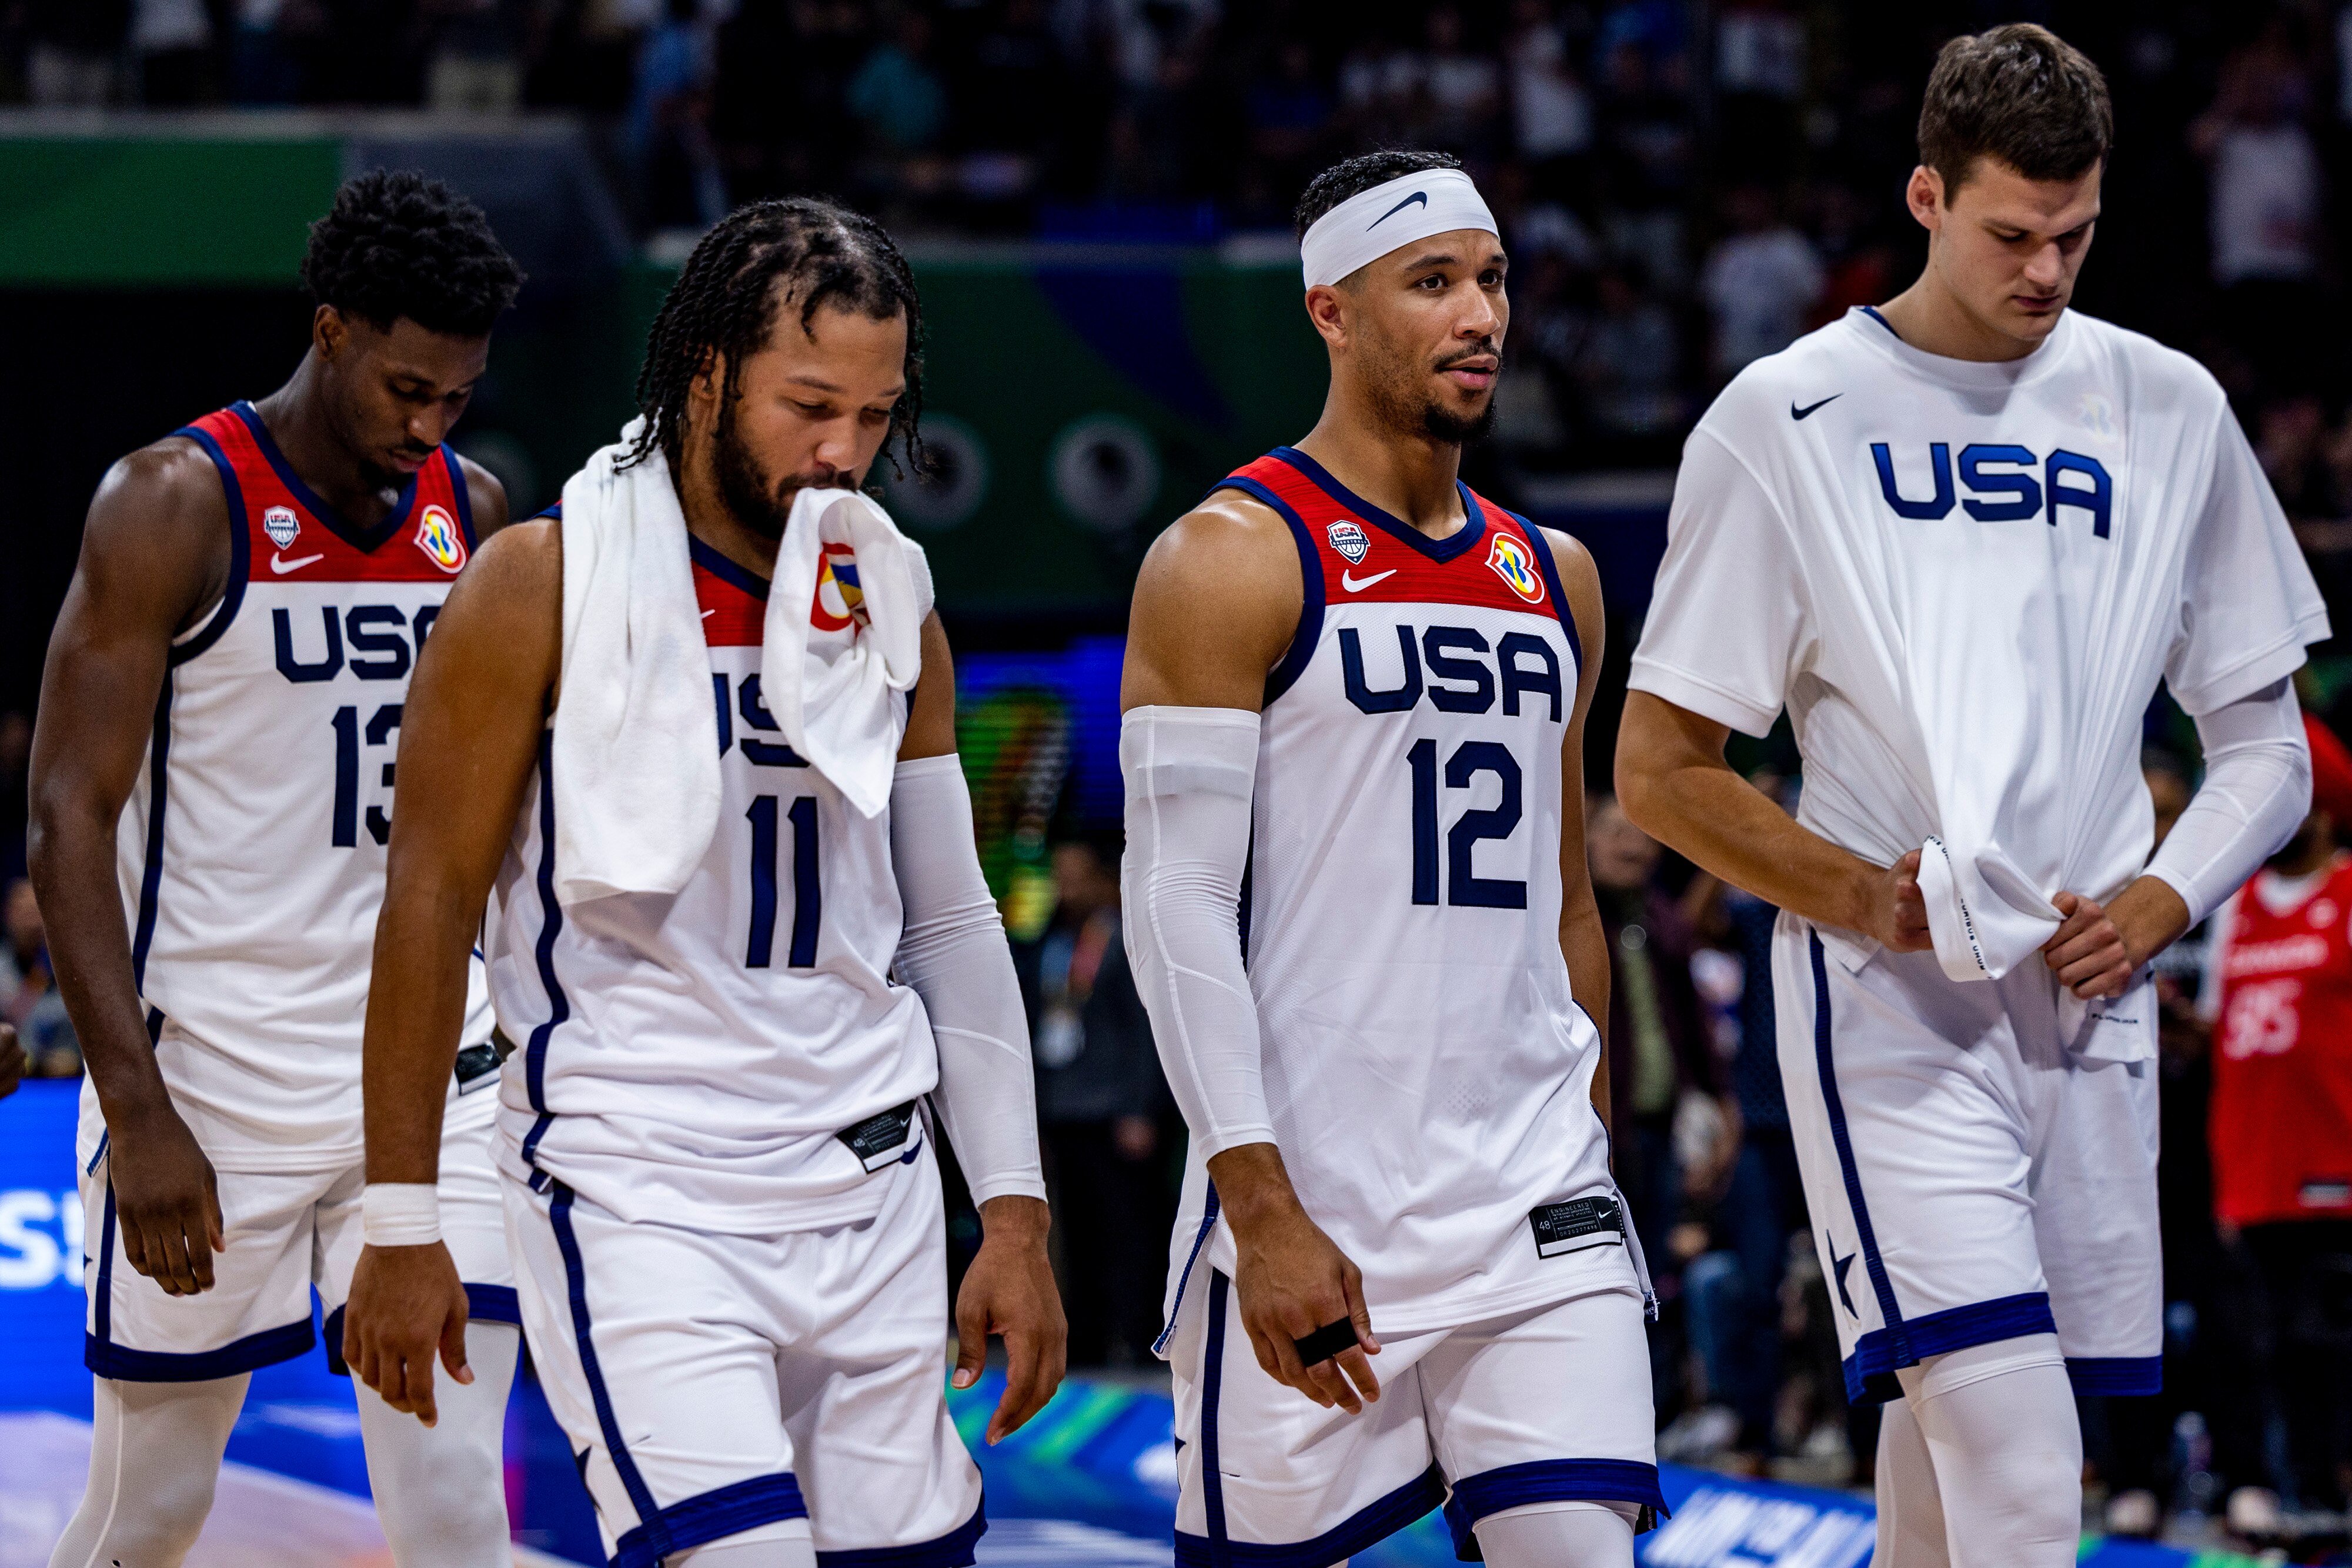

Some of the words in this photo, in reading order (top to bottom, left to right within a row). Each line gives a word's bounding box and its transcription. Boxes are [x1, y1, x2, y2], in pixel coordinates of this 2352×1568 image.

[1333, 527, 1360, 539] USA
[1870, 442, 2112, 540] USA
[272, 605, 442, 683] US
[1338, 624, 1562, 724] USA
[1406, 738, 1528, 910] 12
[746, 795, 821, 968] 11
[1539, 1221, 1551, 1231] 48
[1551, 1202, 1589, 1214] ENGINEERED
